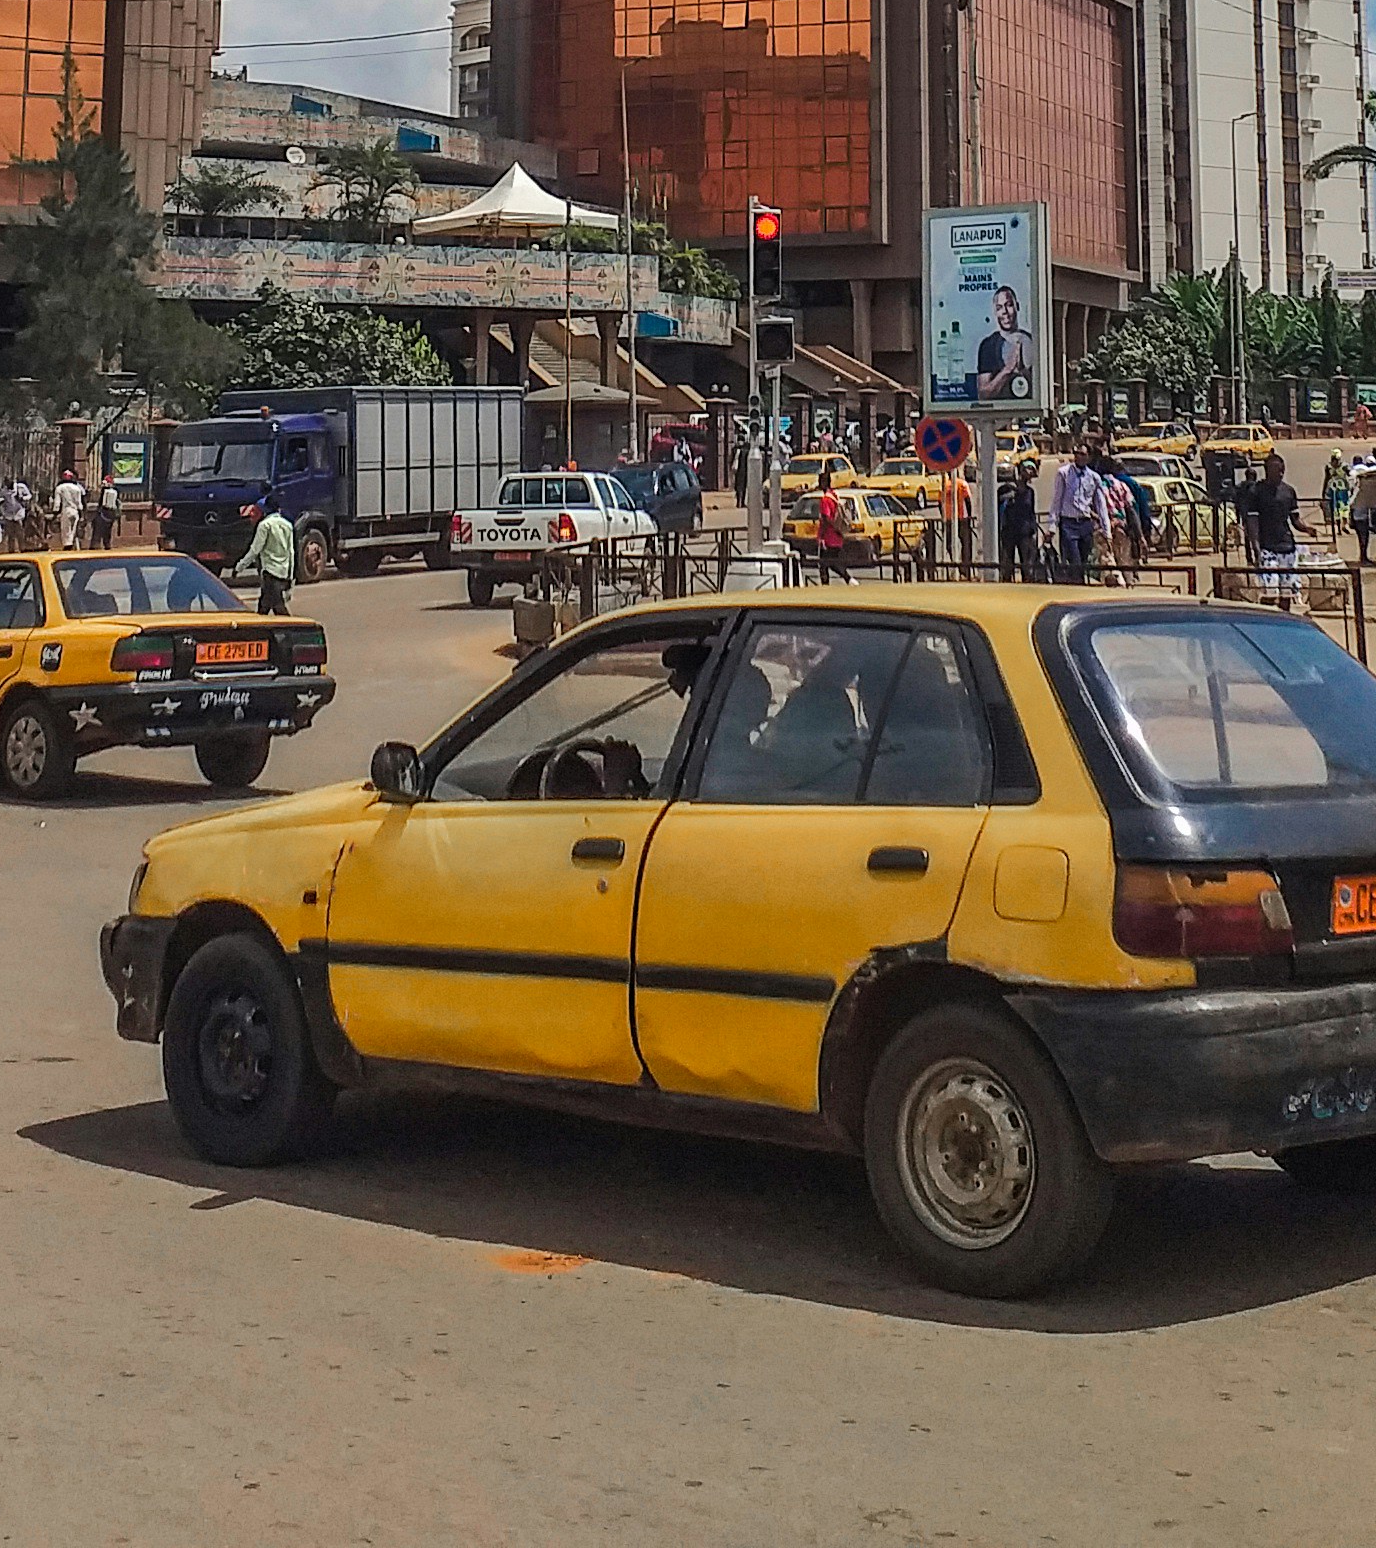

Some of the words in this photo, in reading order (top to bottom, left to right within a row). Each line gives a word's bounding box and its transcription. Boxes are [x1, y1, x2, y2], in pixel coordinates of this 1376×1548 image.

[953, 228, 1003, 243] LANAPUR
[964, 273, 993, 283] MAINS
[958, 281, 999, 293] PROPRES
[477, 528, 542, 542] TOYOTA
